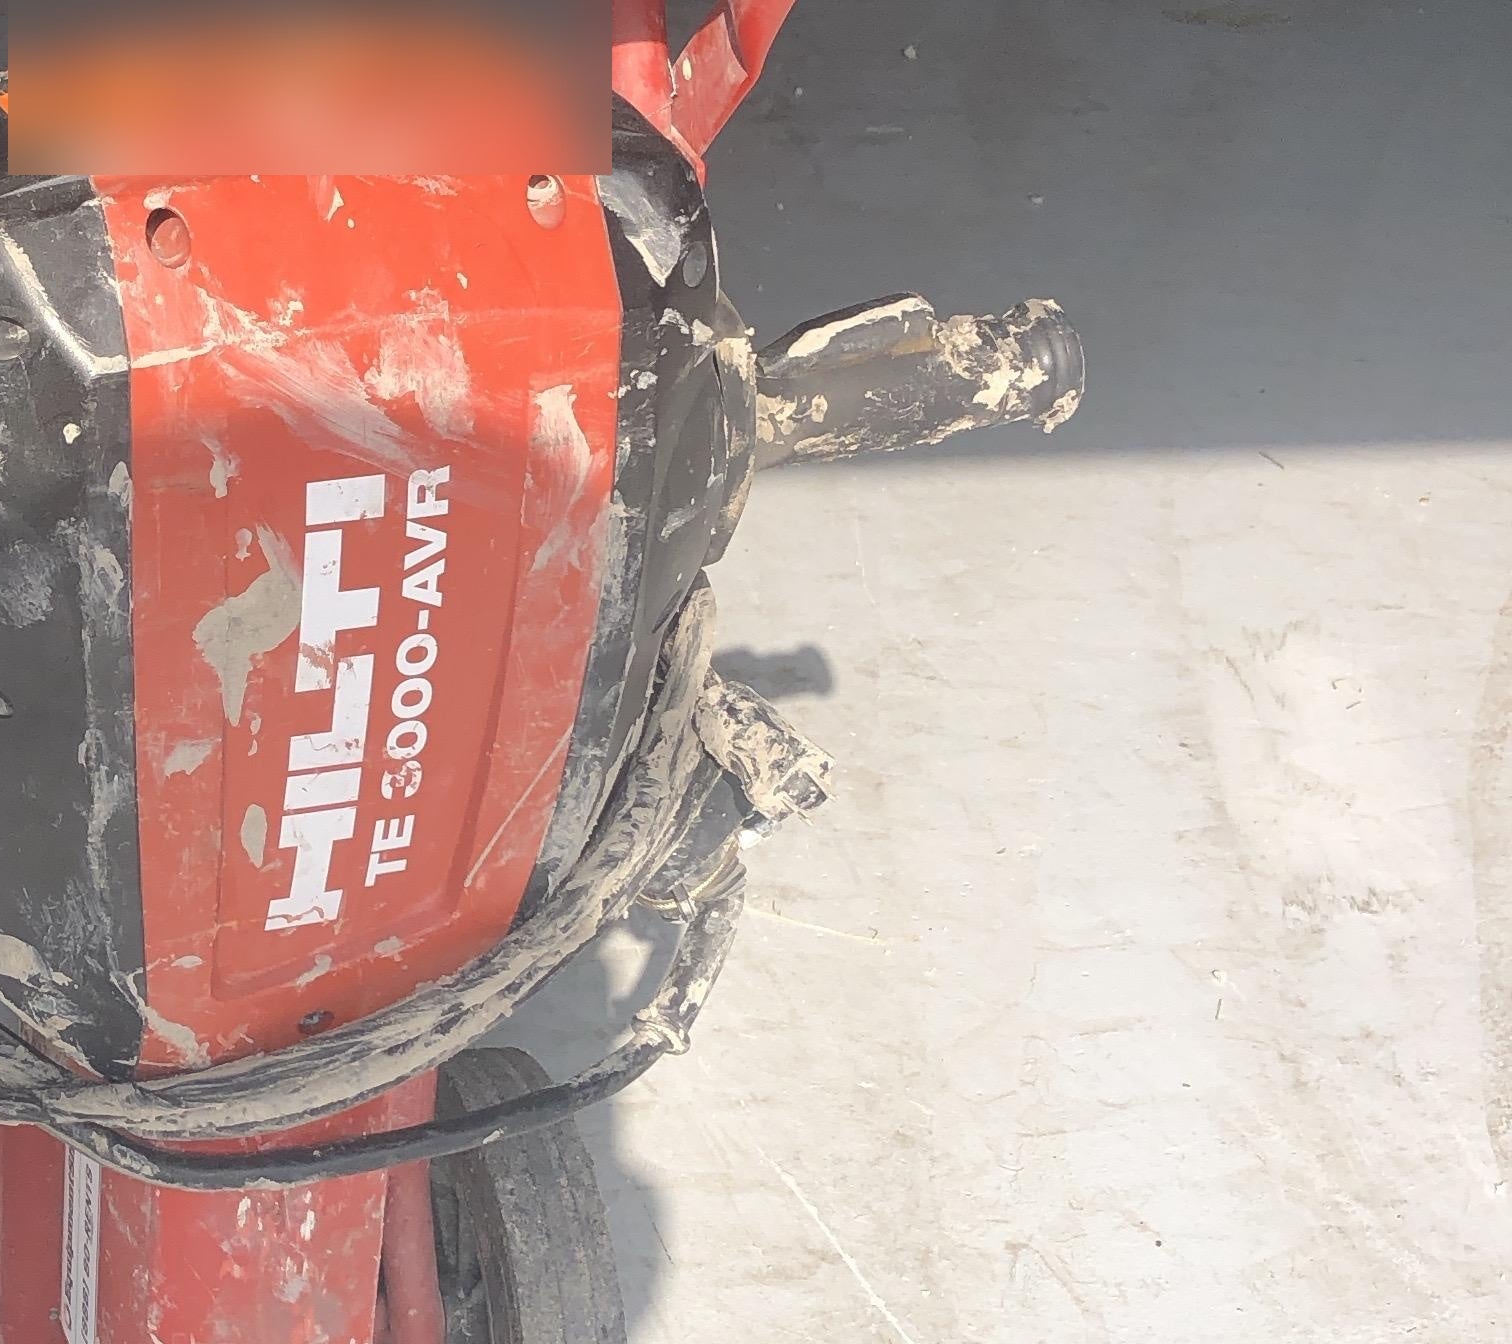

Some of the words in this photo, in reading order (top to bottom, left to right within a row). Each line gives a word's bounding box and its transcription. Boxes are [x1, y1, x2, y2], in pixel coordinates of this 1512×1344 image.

[263, 473, 386, 932] HILTI
[380, 464, 451, 801] 3000-AVR
[364, 813, 416, 888] TE
